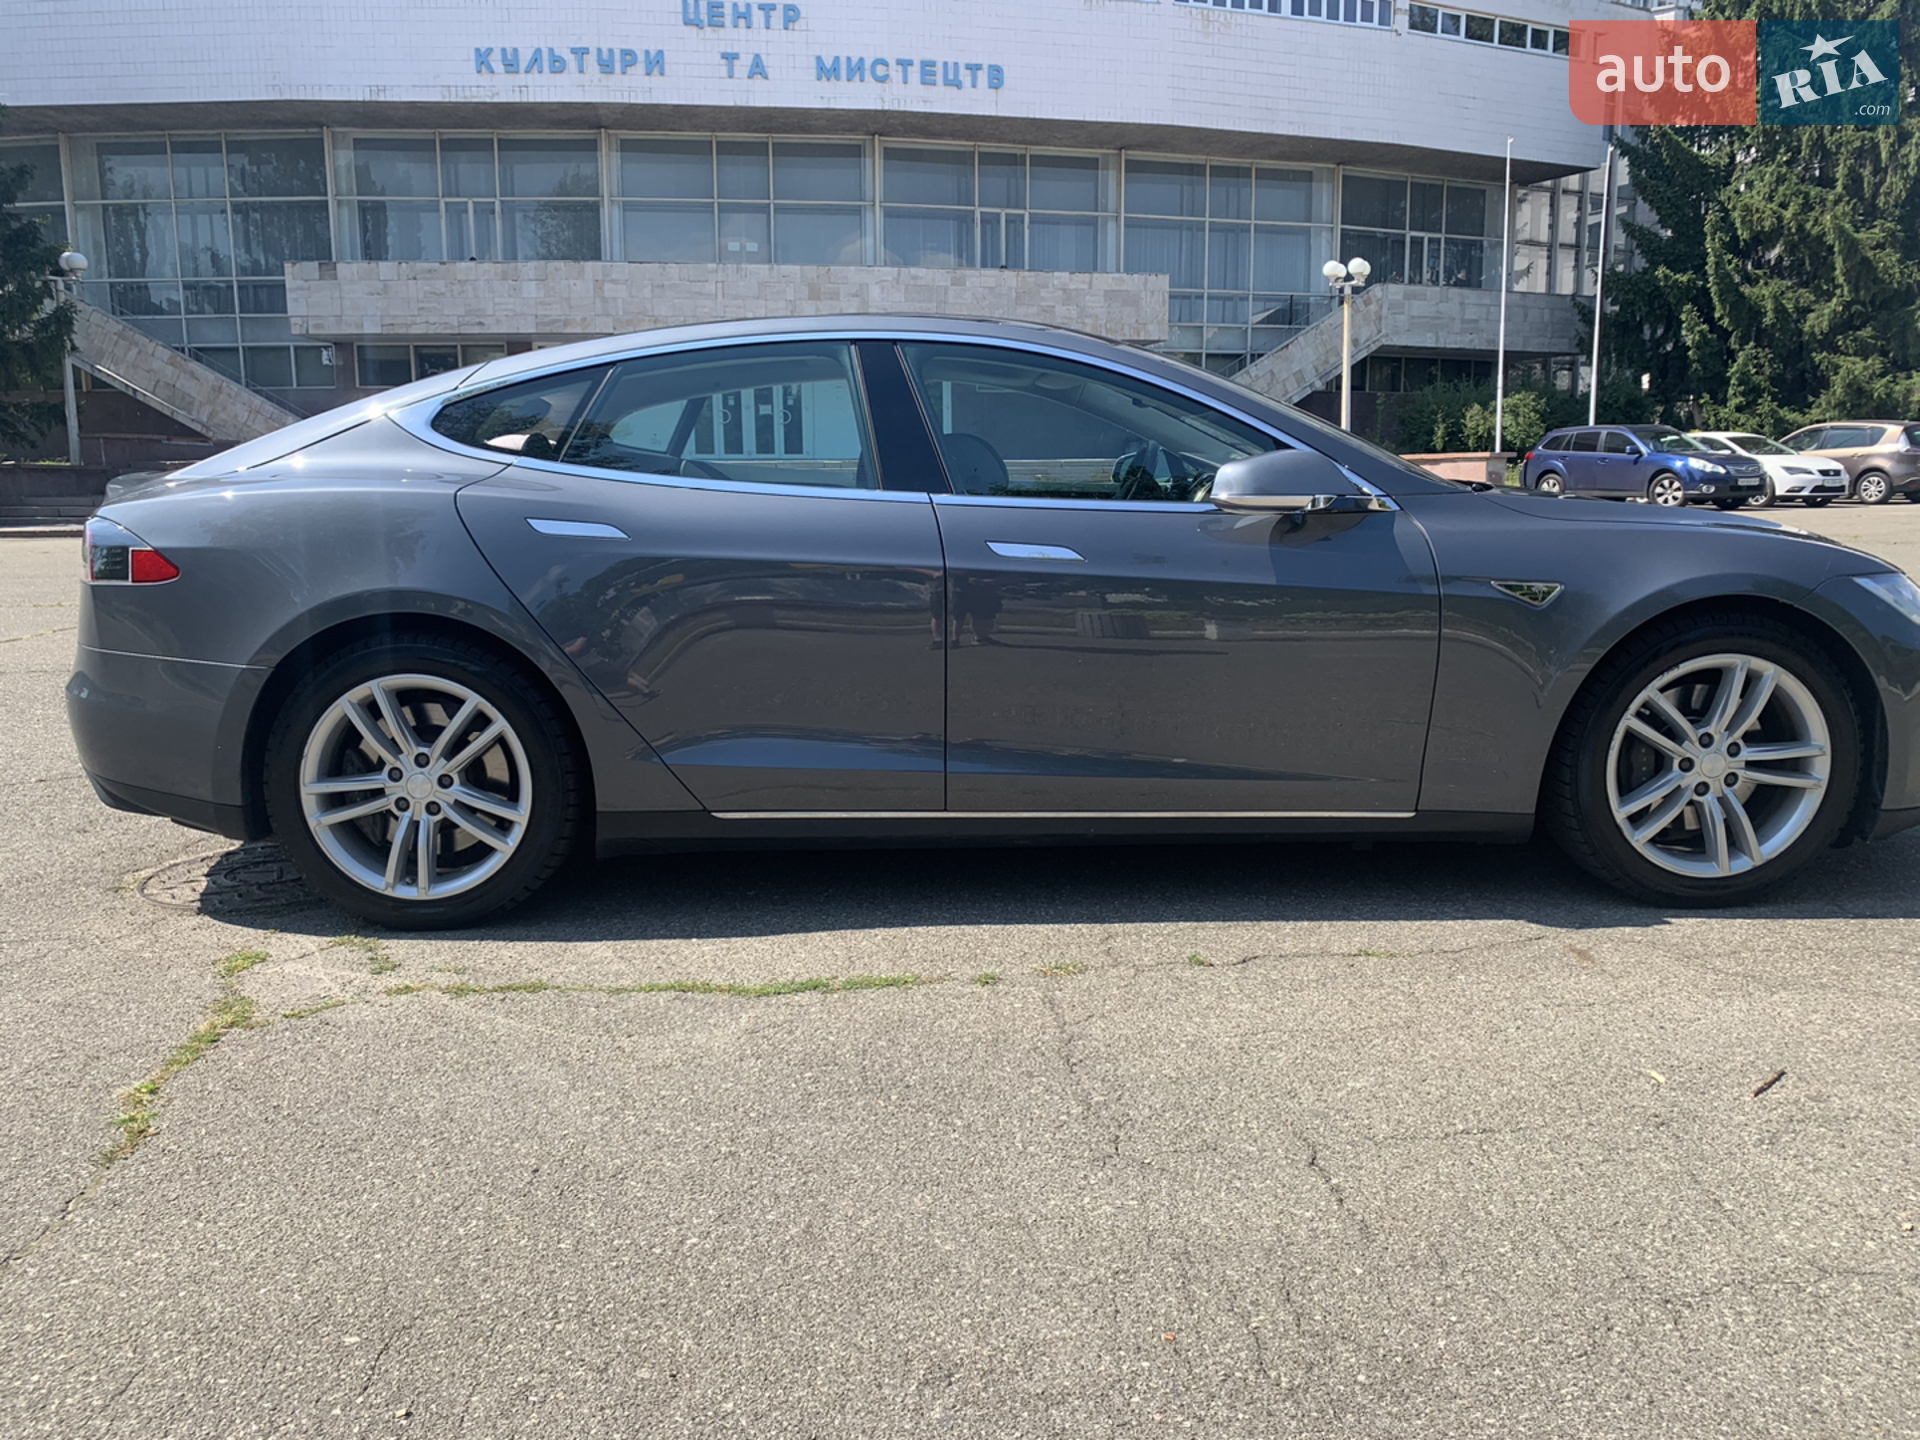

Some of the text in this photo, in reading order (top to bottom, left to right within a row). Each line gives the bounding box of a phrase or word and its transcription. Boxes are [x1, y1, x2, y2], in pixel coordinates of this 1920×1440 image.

[682, 0, 801, 29] ЦЕНТР
[474, 47, 1005, 89] КУЛЬТУРИ ТА МИСТЕЦТВ
